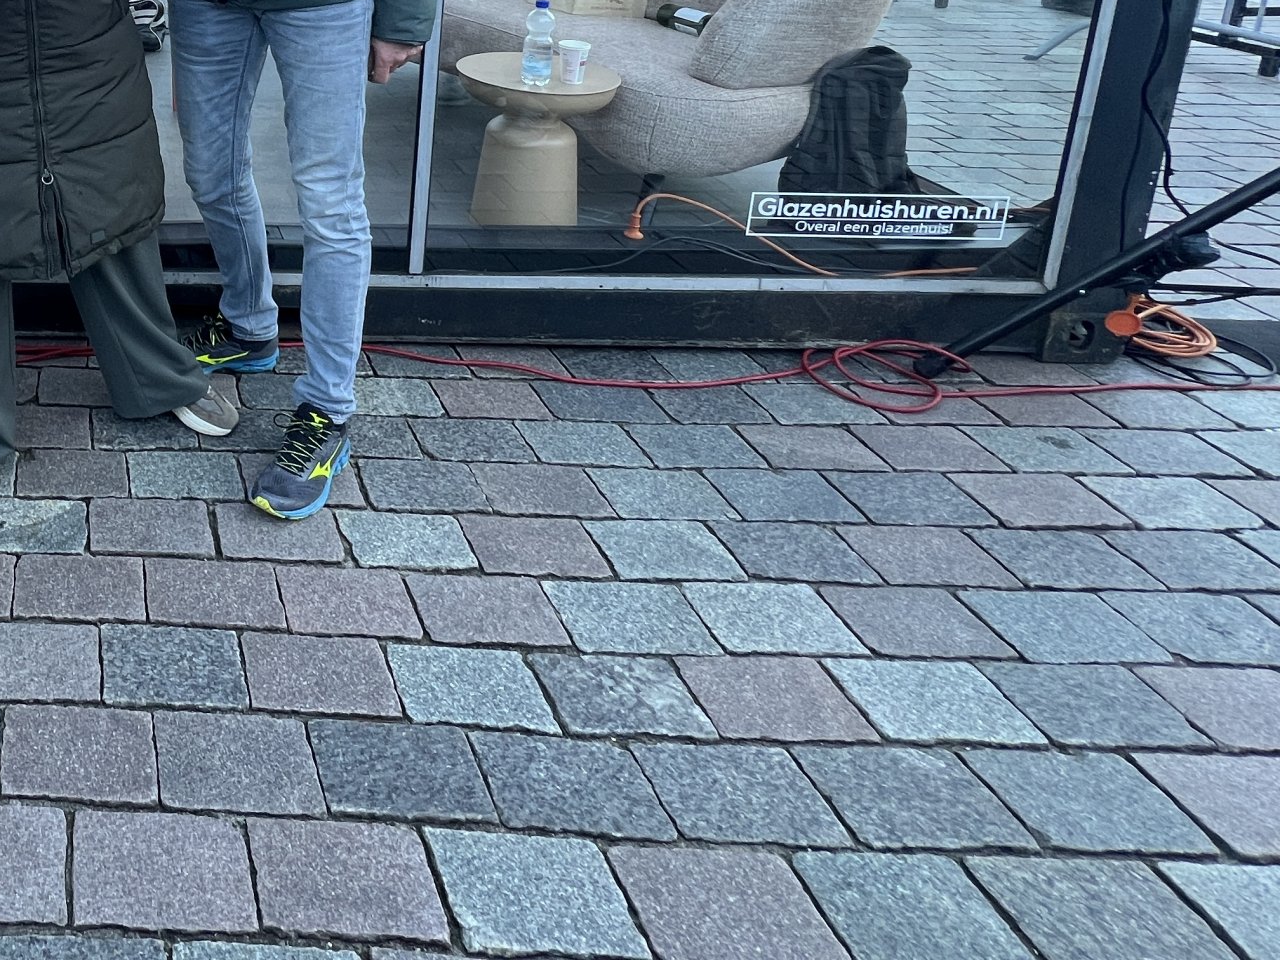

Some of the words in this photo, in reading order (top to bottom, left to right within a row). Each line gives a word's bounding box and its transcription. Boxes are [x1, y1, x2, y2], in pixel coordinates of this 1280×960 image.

[757, 197, 1000, 220] Glazenhuishuren.nl
[795, 220, 841, 233] Overal
[843, 222, 869, 233] een
[872, 222, 954, 236] glazenhuis!
